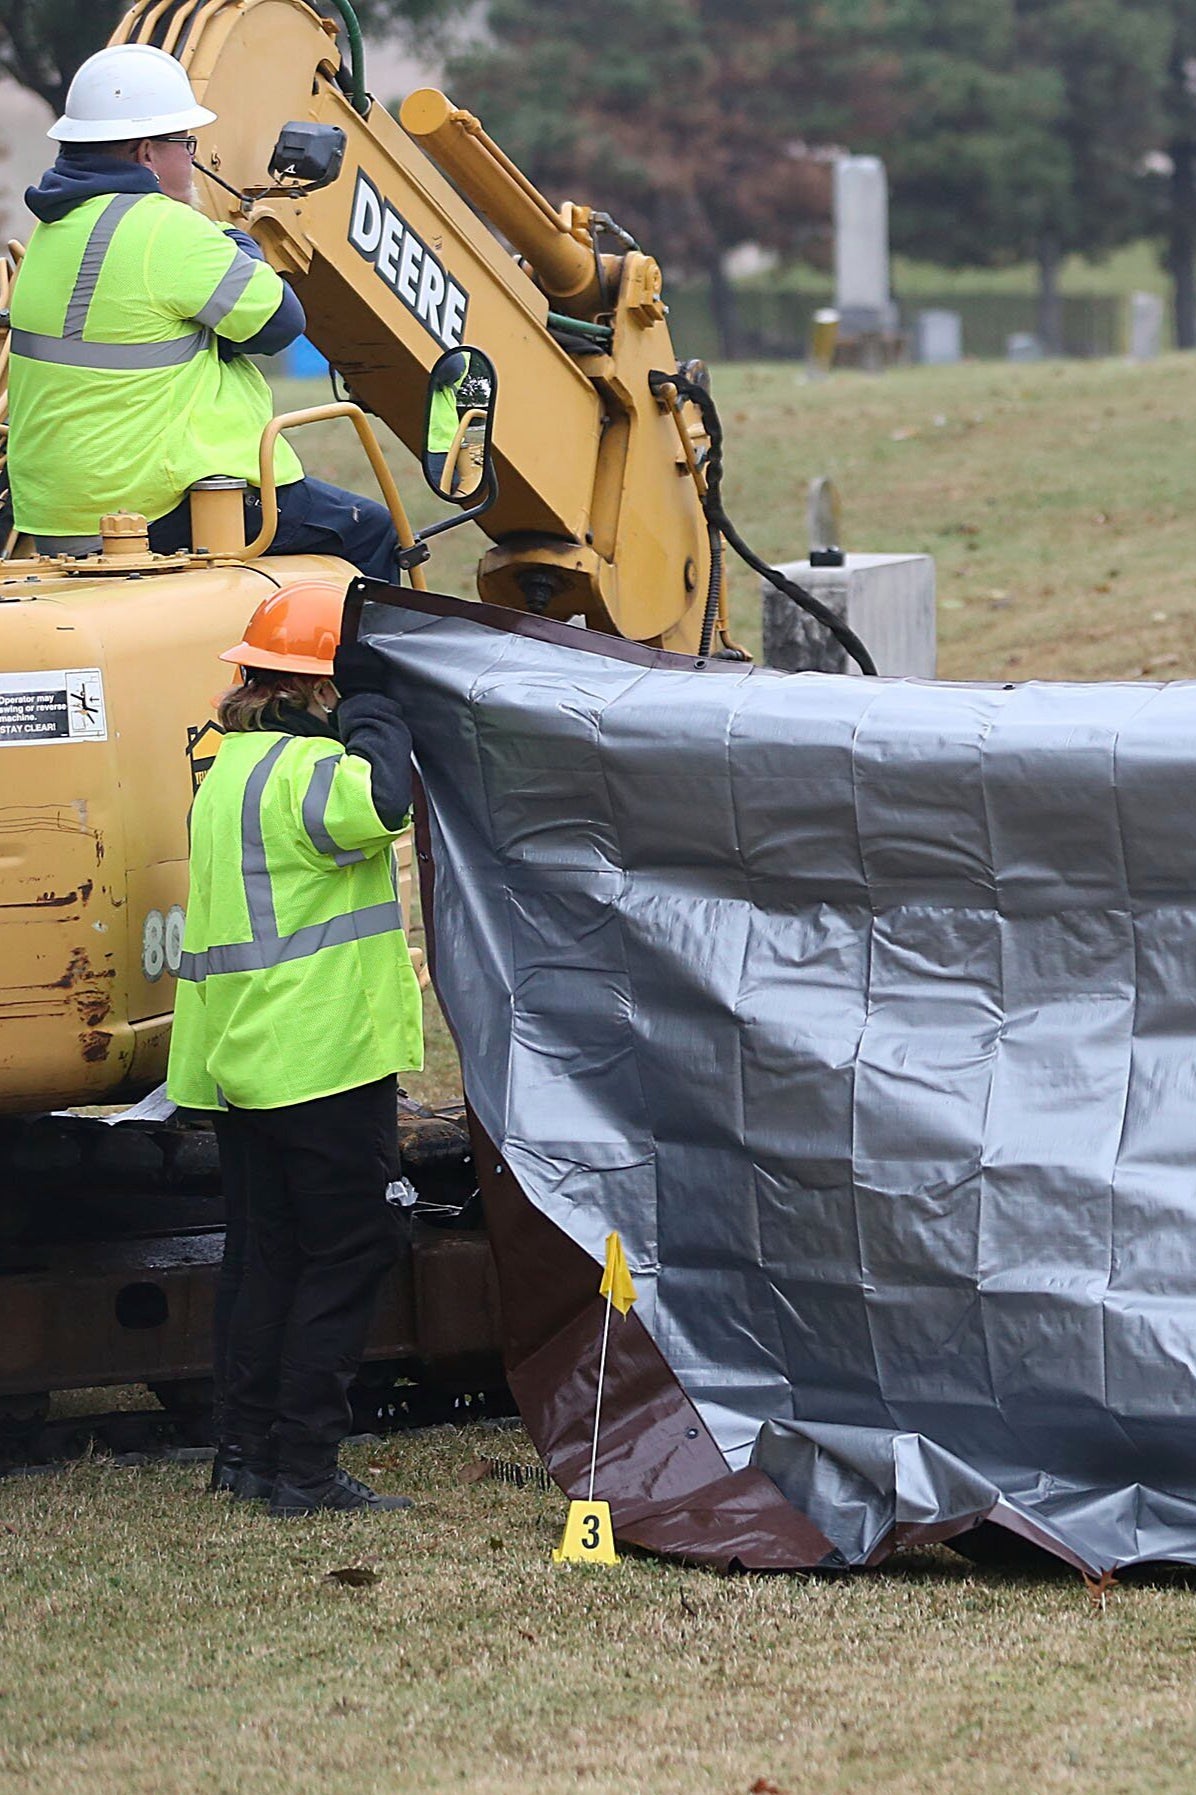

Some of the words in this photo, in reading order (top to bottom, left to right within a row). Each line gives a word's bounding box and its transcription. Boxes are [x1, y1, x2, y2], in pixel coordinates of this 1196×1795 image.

[350, 176, 468, 350] DEERE
[0, 695, 35, 705] Operator
[37, 694, 54, 703] may
[0, 705, 23, 713] swing
[0, 714, 37, 722] machine.
[0, 725, 22, 734] STAY
[24, 723, 56, 732] CLEAR!
[581, 1514, 600, 1550] 3
